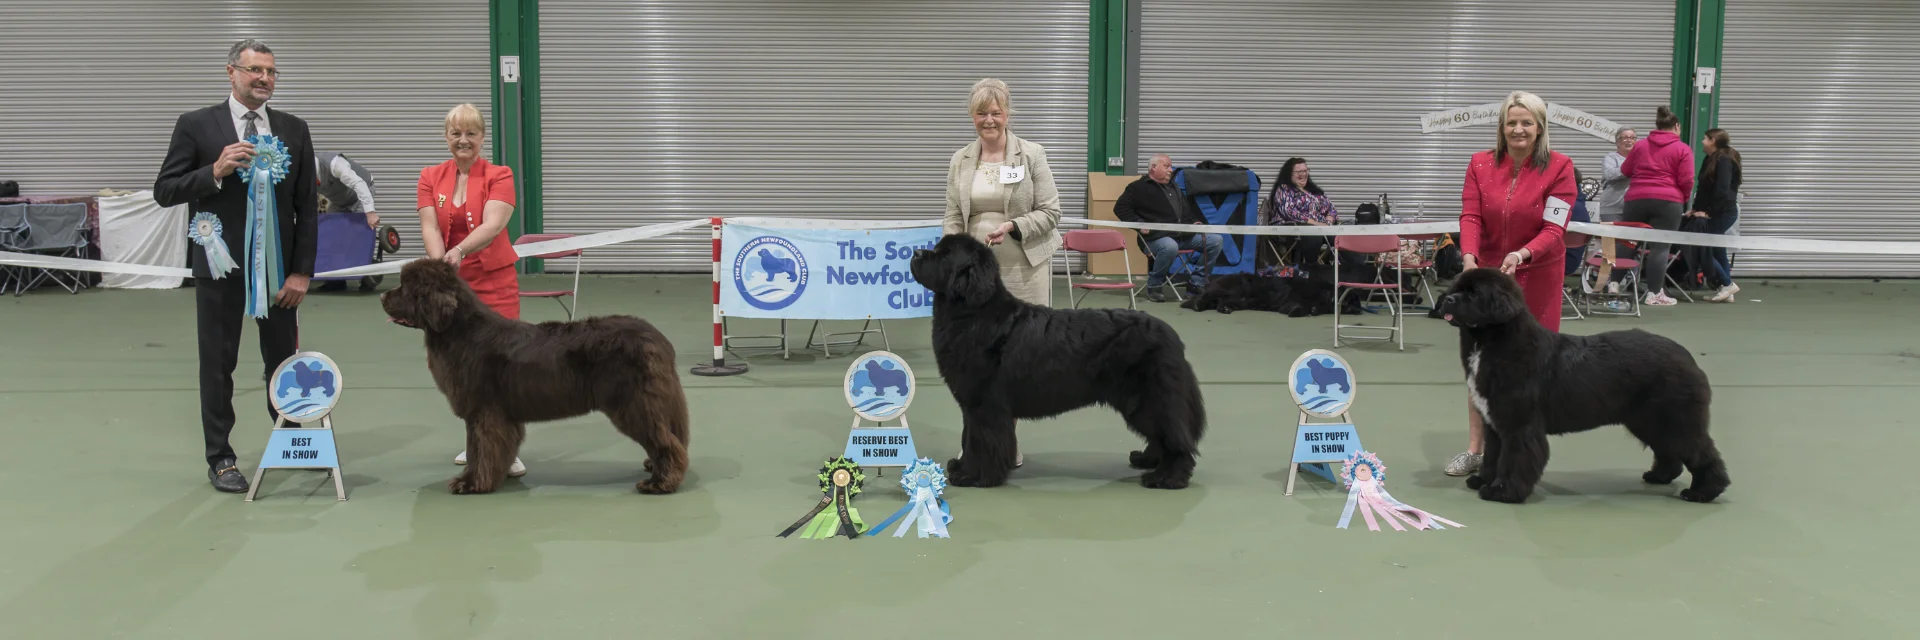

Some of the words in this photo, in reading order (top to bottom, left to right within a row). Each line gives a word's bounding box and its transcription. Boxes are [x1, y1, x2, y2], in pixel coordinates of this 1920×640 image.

[1428, 115, 1452, 128] Happy
[1454, 111, 1470, 123] 60
[1472, 109, 1500, 119] Birthda
[1552, 108, 1575, 124] Happy
[1576, 116, 1593, 128] 60
[1553, 207, 1560, 216] 6
[736, 239, 760, 267] SOUTHERN
[761, 237, 806, 267] NEWFOUNDLAND
[836, 239, 877, 261] The
[826, 264, 917, 286] Newfou
[887, 288, 935, 310] Club
[853, 436, 887, 445] RESERVE
[889, 436, 908, 445] BEST
[1304, 432, 1323, 441] BEST
[1325, 432, 1349, 441] PUPPY
[291, 437, 312, 447] BEST
[862, 448, 871, 457] IN
[872, 448, 898, 457] SHOW
[1311, 444, 1320, 453] IN
[1321, 444, 1345, 453] SHOW
[282, 450, 291, 459] IN
[292, 450, 318, 459] SHOW
